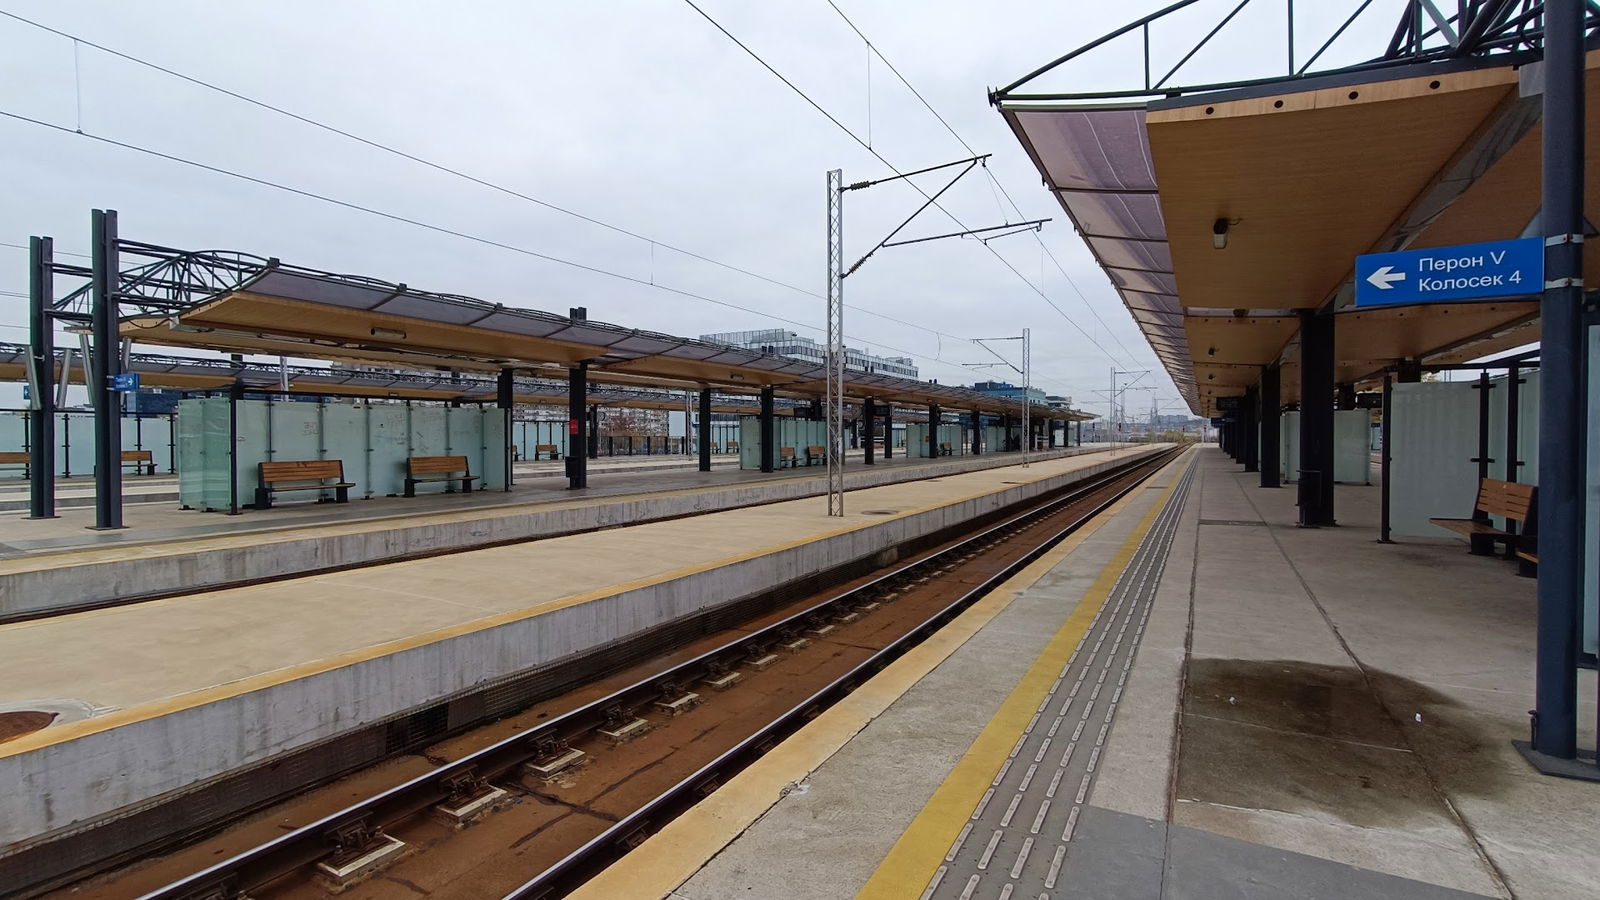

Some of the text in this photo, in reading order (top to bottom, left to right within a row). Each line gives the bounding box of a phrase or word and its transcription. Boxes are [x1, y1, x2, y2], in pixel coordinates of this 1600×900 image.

[1419, 250, 1506, 273] Перон V
[1418, 270, 1522, 292] Колосек 4
